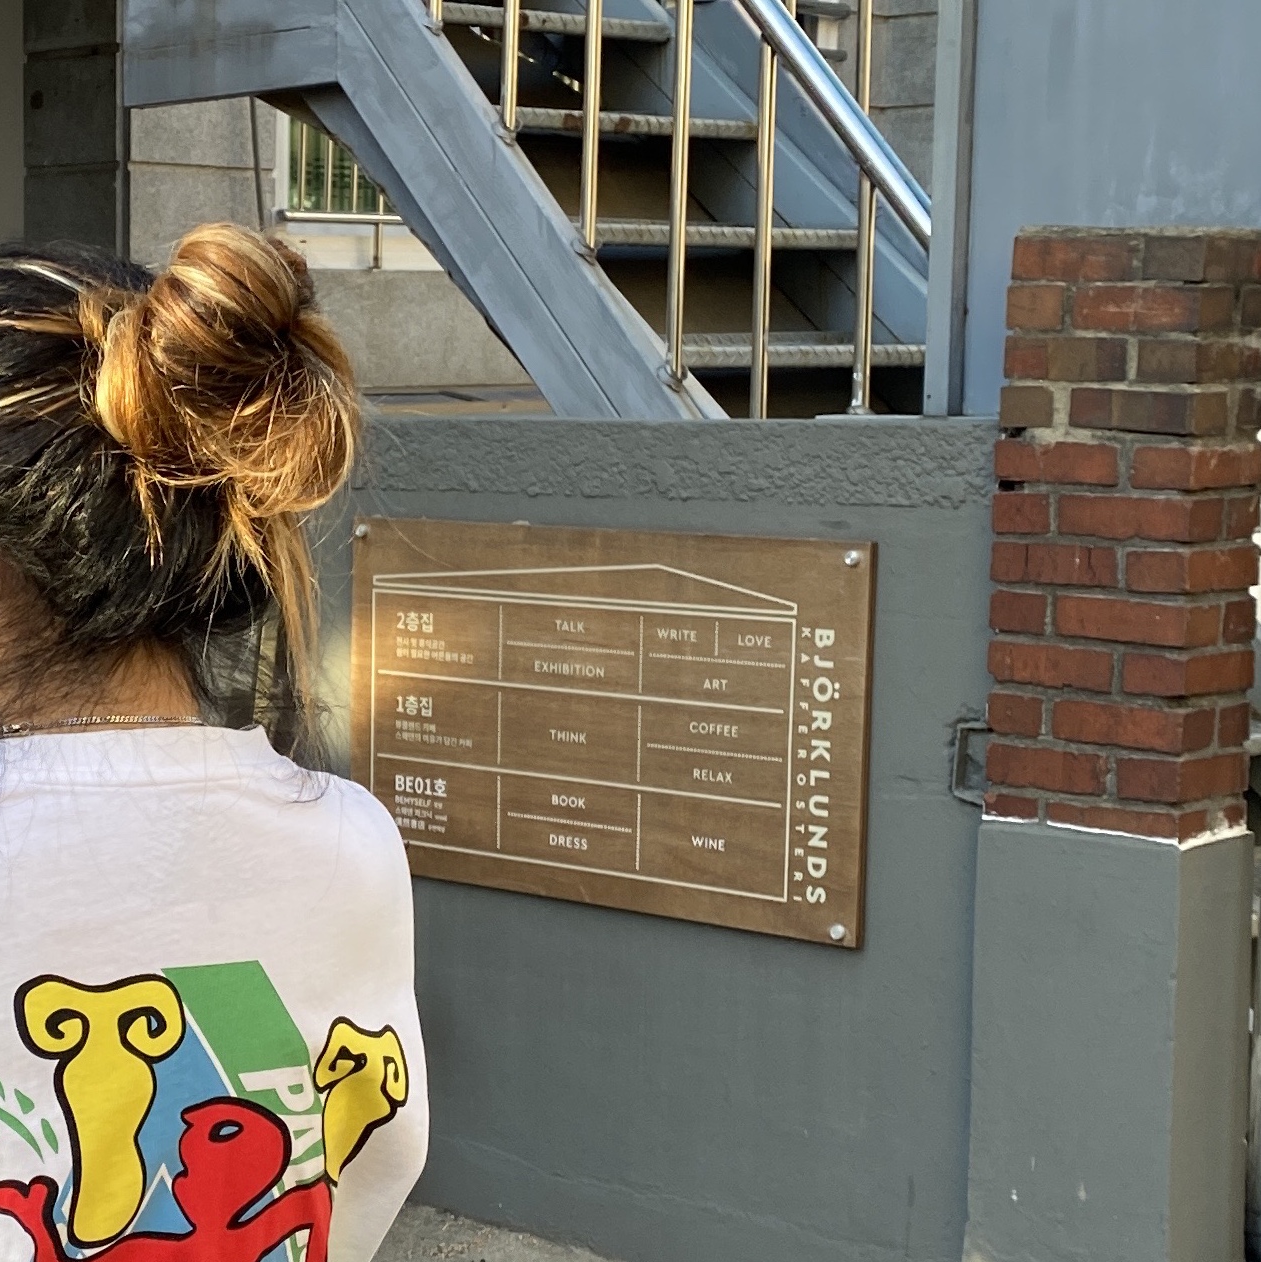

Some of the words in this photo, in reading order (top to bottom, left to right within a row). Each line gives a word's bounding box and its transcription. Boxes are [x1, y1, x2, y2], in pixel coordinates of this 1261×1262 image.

[396, 611, 434, 634] 2층집
[555, 619, 586, 634] TALK
[656, 627, 698, 643] WRITE
[737, 633, 772, 648] LOVE
[534, 660, 605, 678] EXHIBITION
[703, 678, 728, 691] ART
[395, 694, 433, 717] 1층집
[549, 729, 587, 744] THINK
[689, 721, 739, 738] COFFEE
[791, 626, 813, 902] KAFFEROSTERI
[805, 628, 841, 904] BJÖRKLUNDS
[693, 768, 733, 784] RELAX
[394, 774, 448, 798] BE01호
[551, 794, 586, 809] BOOK
[549, 834, 588, 850] DRESS
[691, 835, 726, 852] WINE
